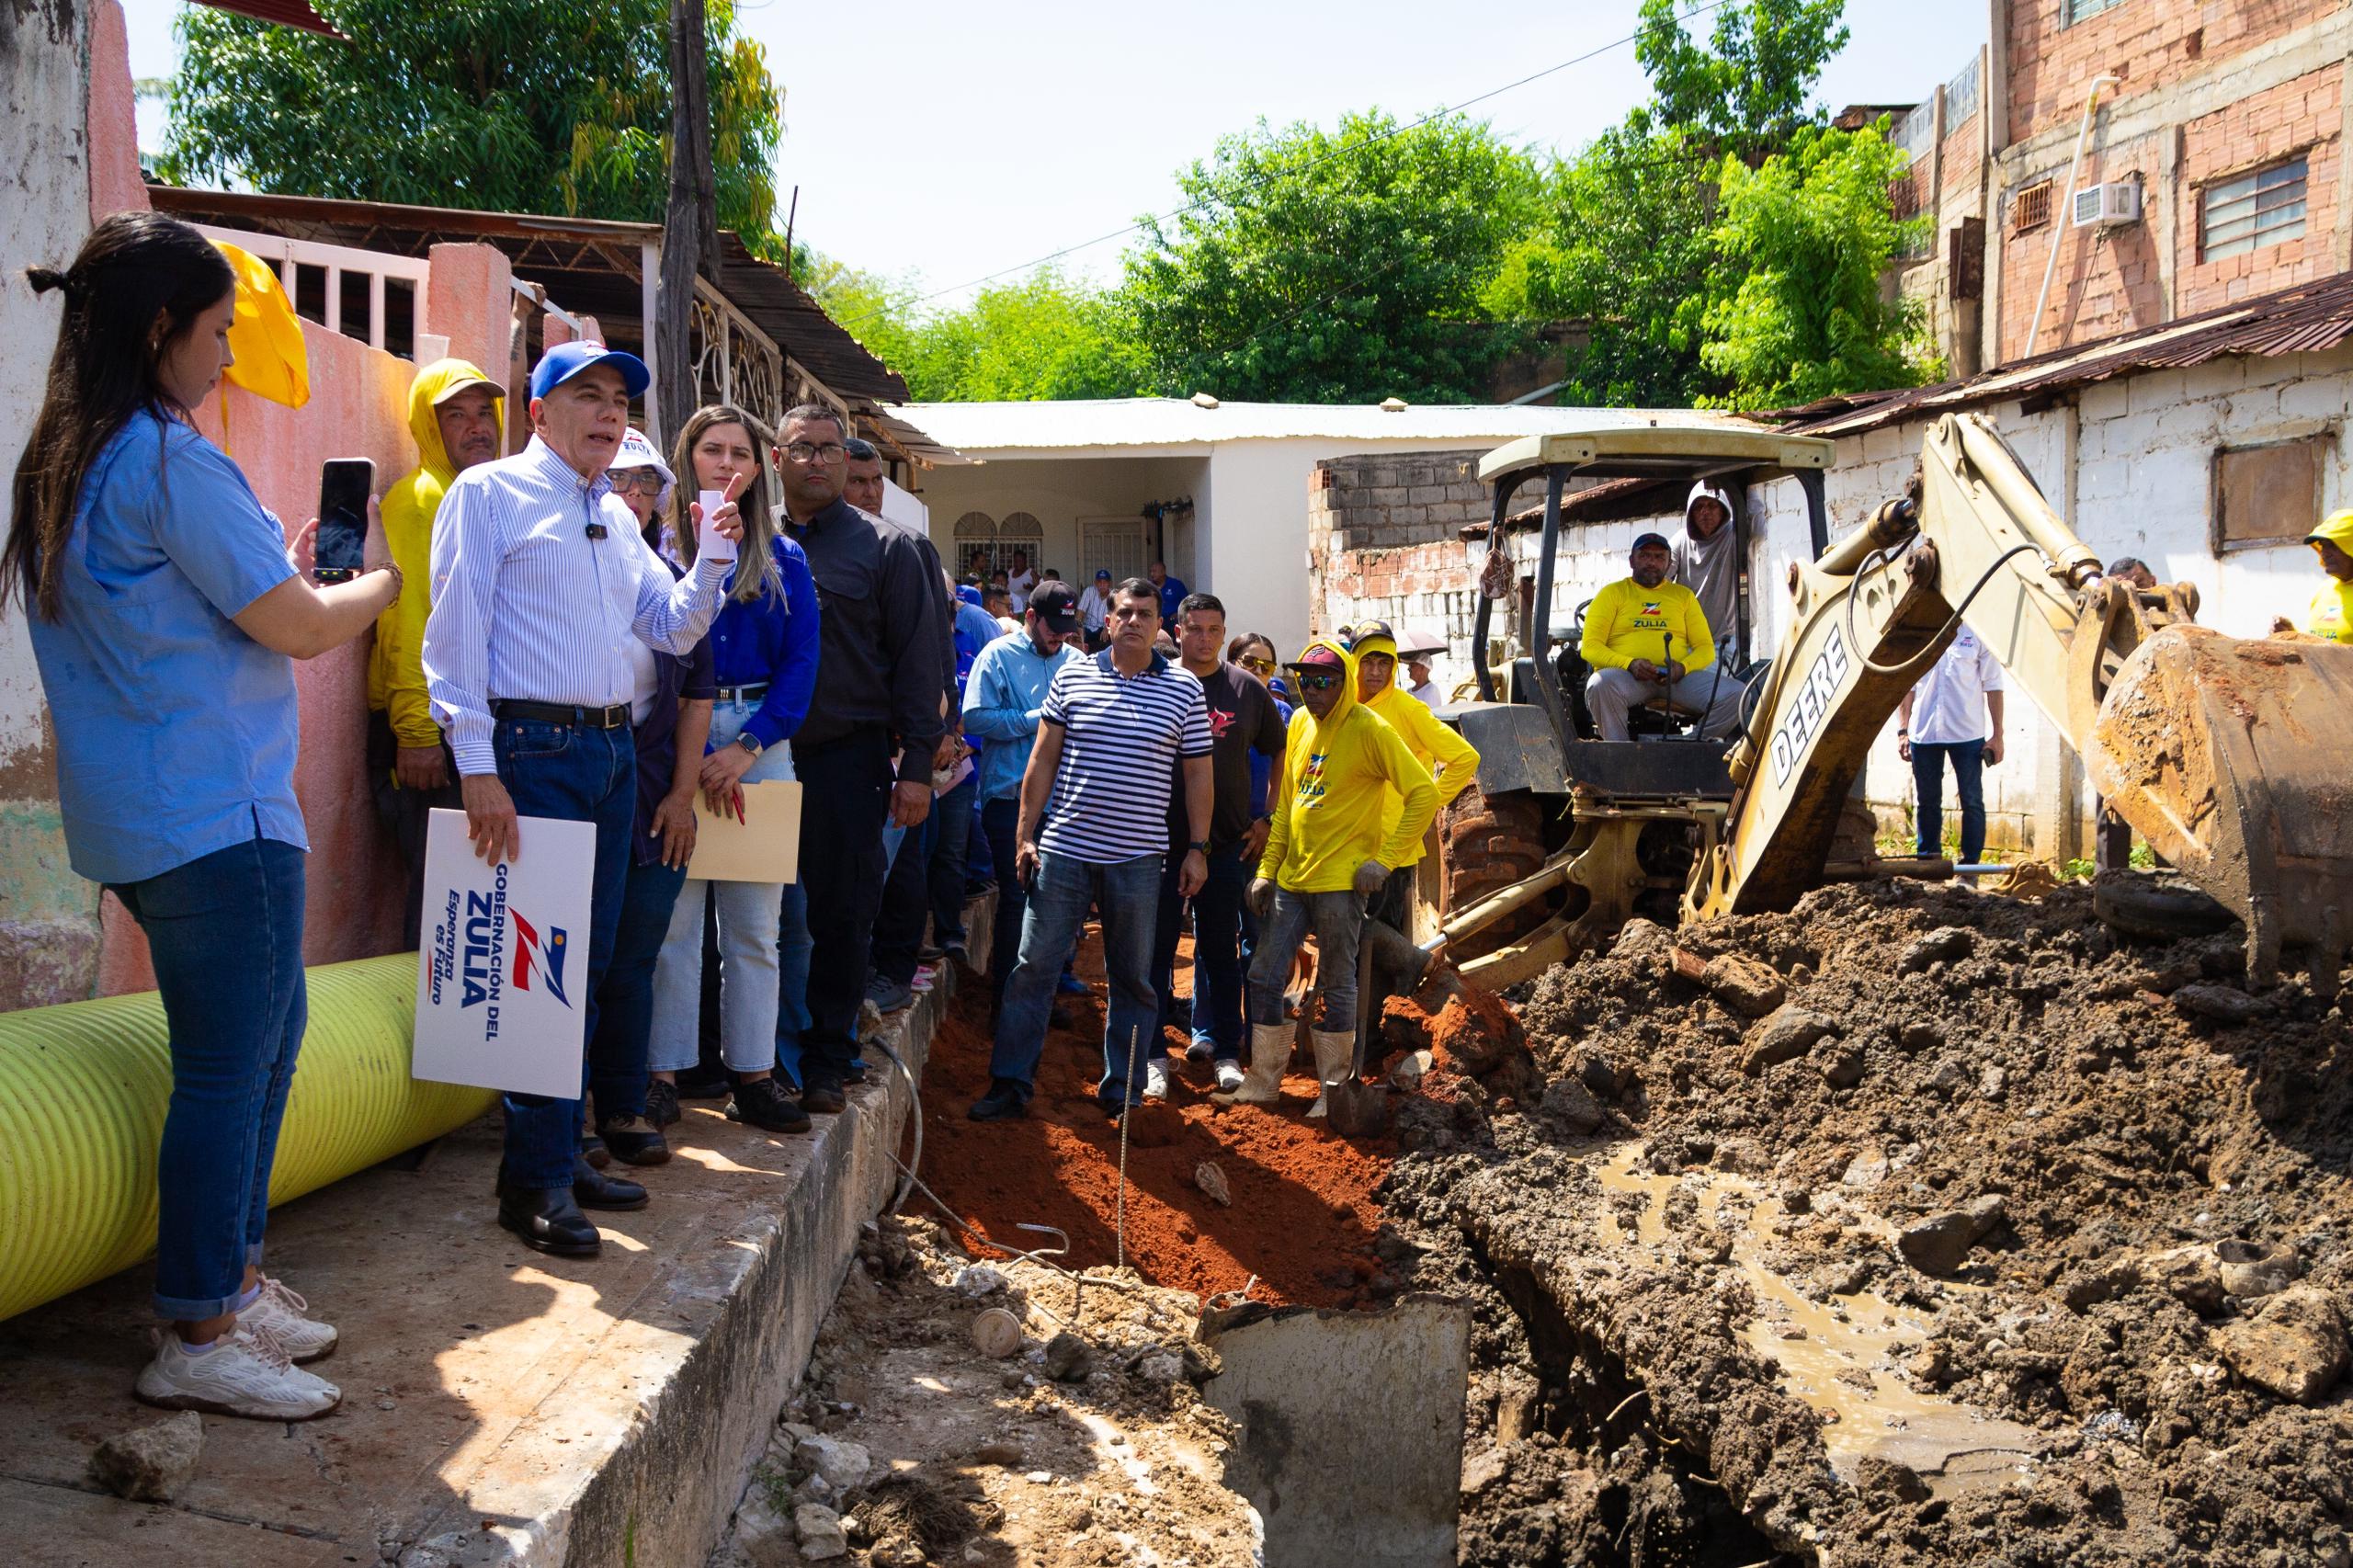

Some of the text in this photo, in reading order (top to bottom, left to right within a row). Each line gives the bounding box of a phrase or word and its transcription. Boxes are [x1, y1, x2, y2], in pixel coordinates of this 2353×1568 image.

[1633, 619, 1667, 628] ZULIA
[1769, 621, 1848, 790] DEERE
[431, 924, 447, 1006] es Futuro
[442, 888, 460, 983] Esperanza
[460, 889, 494, 1009] ZULIA
[485, 862, 508, 1042] GOBERNACIÓN DEL
